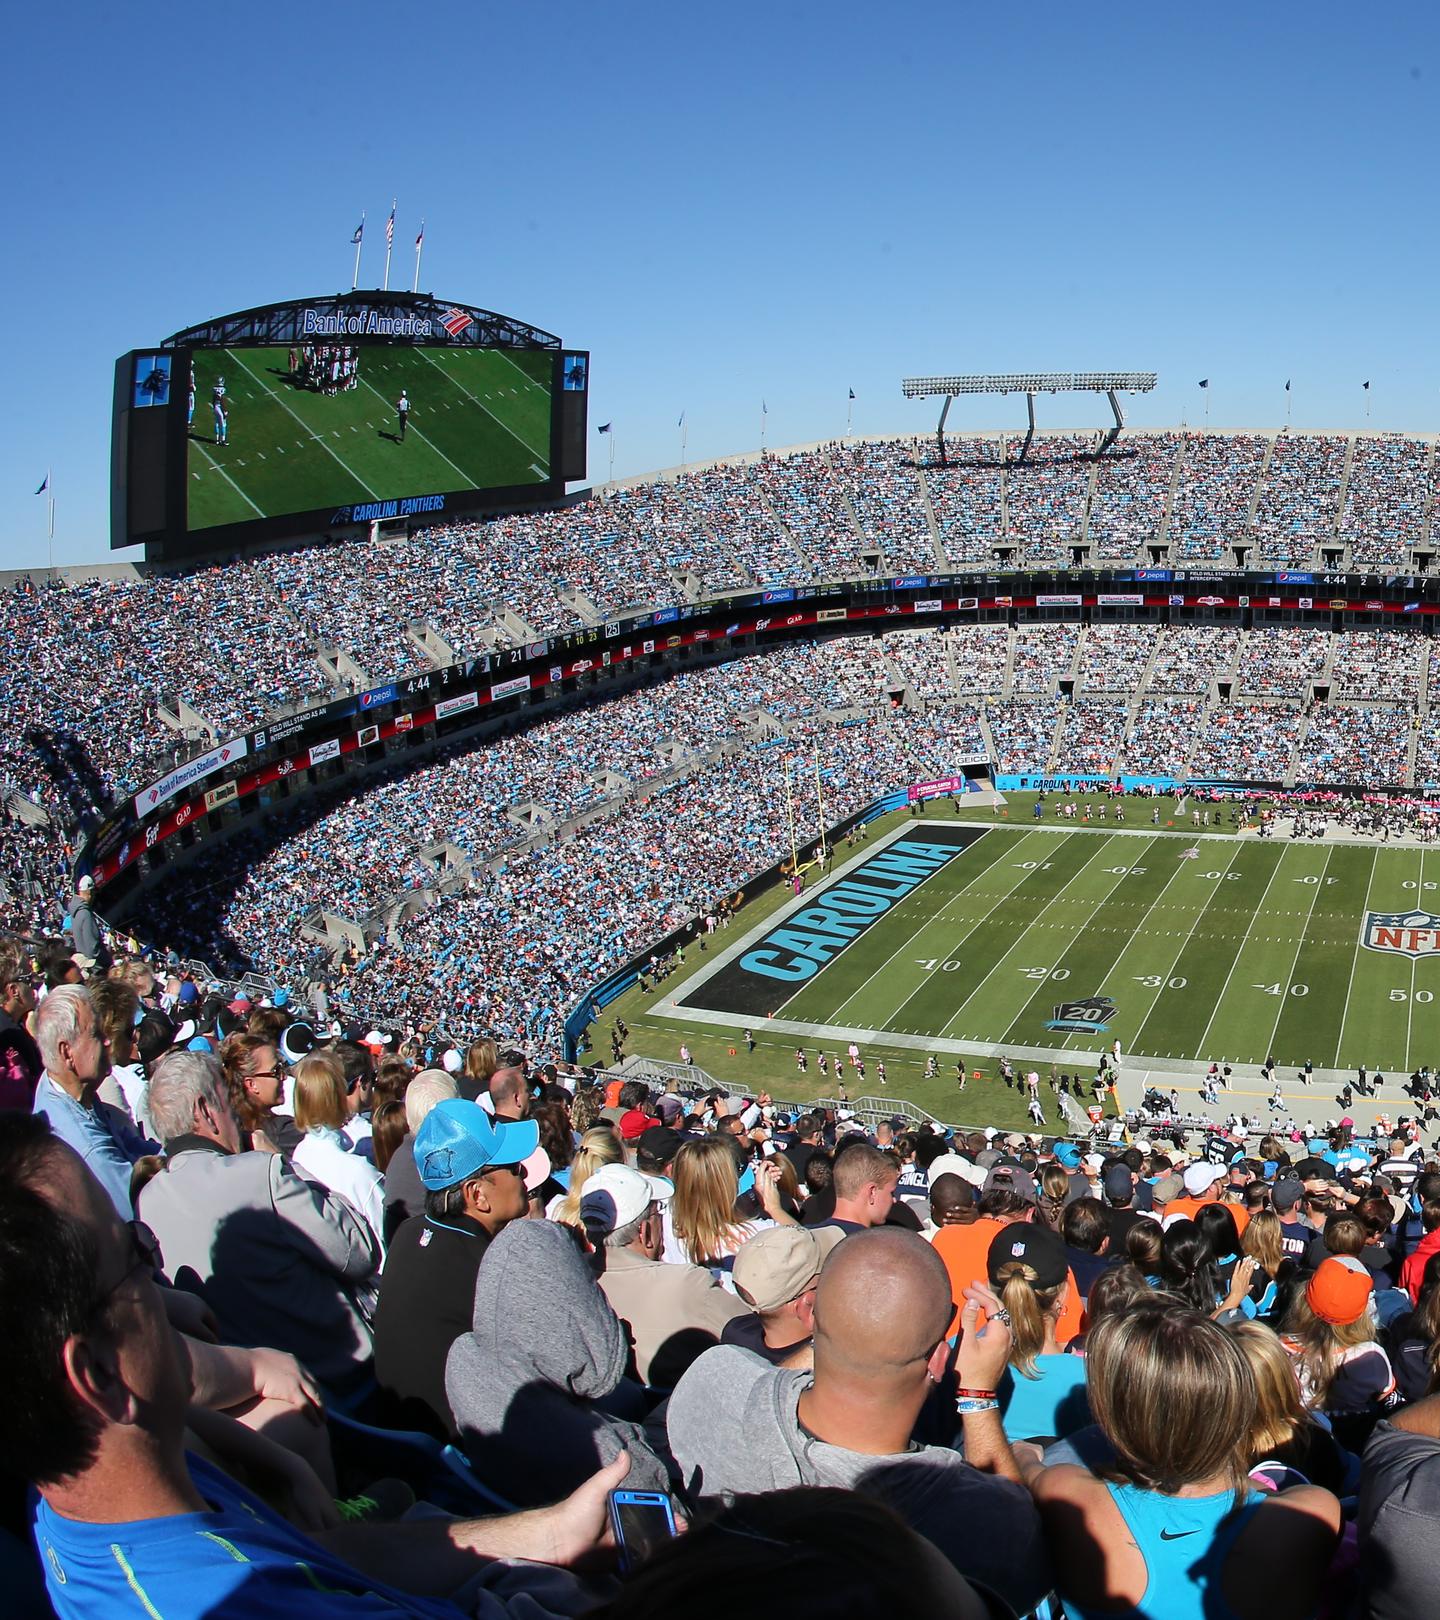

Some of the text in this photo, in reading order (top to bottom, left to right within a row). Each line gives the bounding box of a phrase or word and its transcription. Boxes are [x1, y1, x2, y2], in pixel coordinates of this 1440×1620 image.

[304, 309, 432, 336] Bank of America
[353, 495, 445, 522] CAROLINA PANTHERS
[1147, 571, 1165, 580] pepsi
[1289, 573, 1307, 583] pepsi
[1323, 575, 1346, 585] 4:44
[1361, 578, 1367, 586] 2
[1421, 578, 1427, 587] 7
[904, 578, 921, 588] pepsi
[787, 615, 802, 625] GLAD
[589, 632, 597, 642] 23
[607, 623, 618, 637] 25
[576, 636, 584, 646] 10
[495, 655, 501, 667] 7
[511, 650, 522, 663] 21
[407, 675, 430, 693] 4:44
[442, 674, 449, 684] 2
[373, 688, 392, 702] pepsi
[270, 723, 282, 733] FIELD
[282, 720, 293, 730] WILL
[294, 715, 310, 726] STAND
[319, 709, 327, 717] AN
[957, 755, 988, 765] GEICO
[159, 784, 172, 798] Bank
[176, 768, 197, 787] America
[197, 757, 219, 774] Stadium
[1033, 779, 1070, 789] CAROLIN
[176, 805, 191, 825] GLAD
[1402, 880, 1438, 890] 50
[738, 840, 964, 983] CAROLINA
[925, 958, 962, 972] 10
[1029, 967, 1071, 981] 20
[1143, 975, 1187, 990] 30
[1264, 982, 1309, 997] 40
[1389, 989, 1434, 1004] 50
[1064, 1007, 1102, 1021] 20
[898, 1172, 928, 1188] SINGL
[1282, 1237, 1305, 1254] TON
